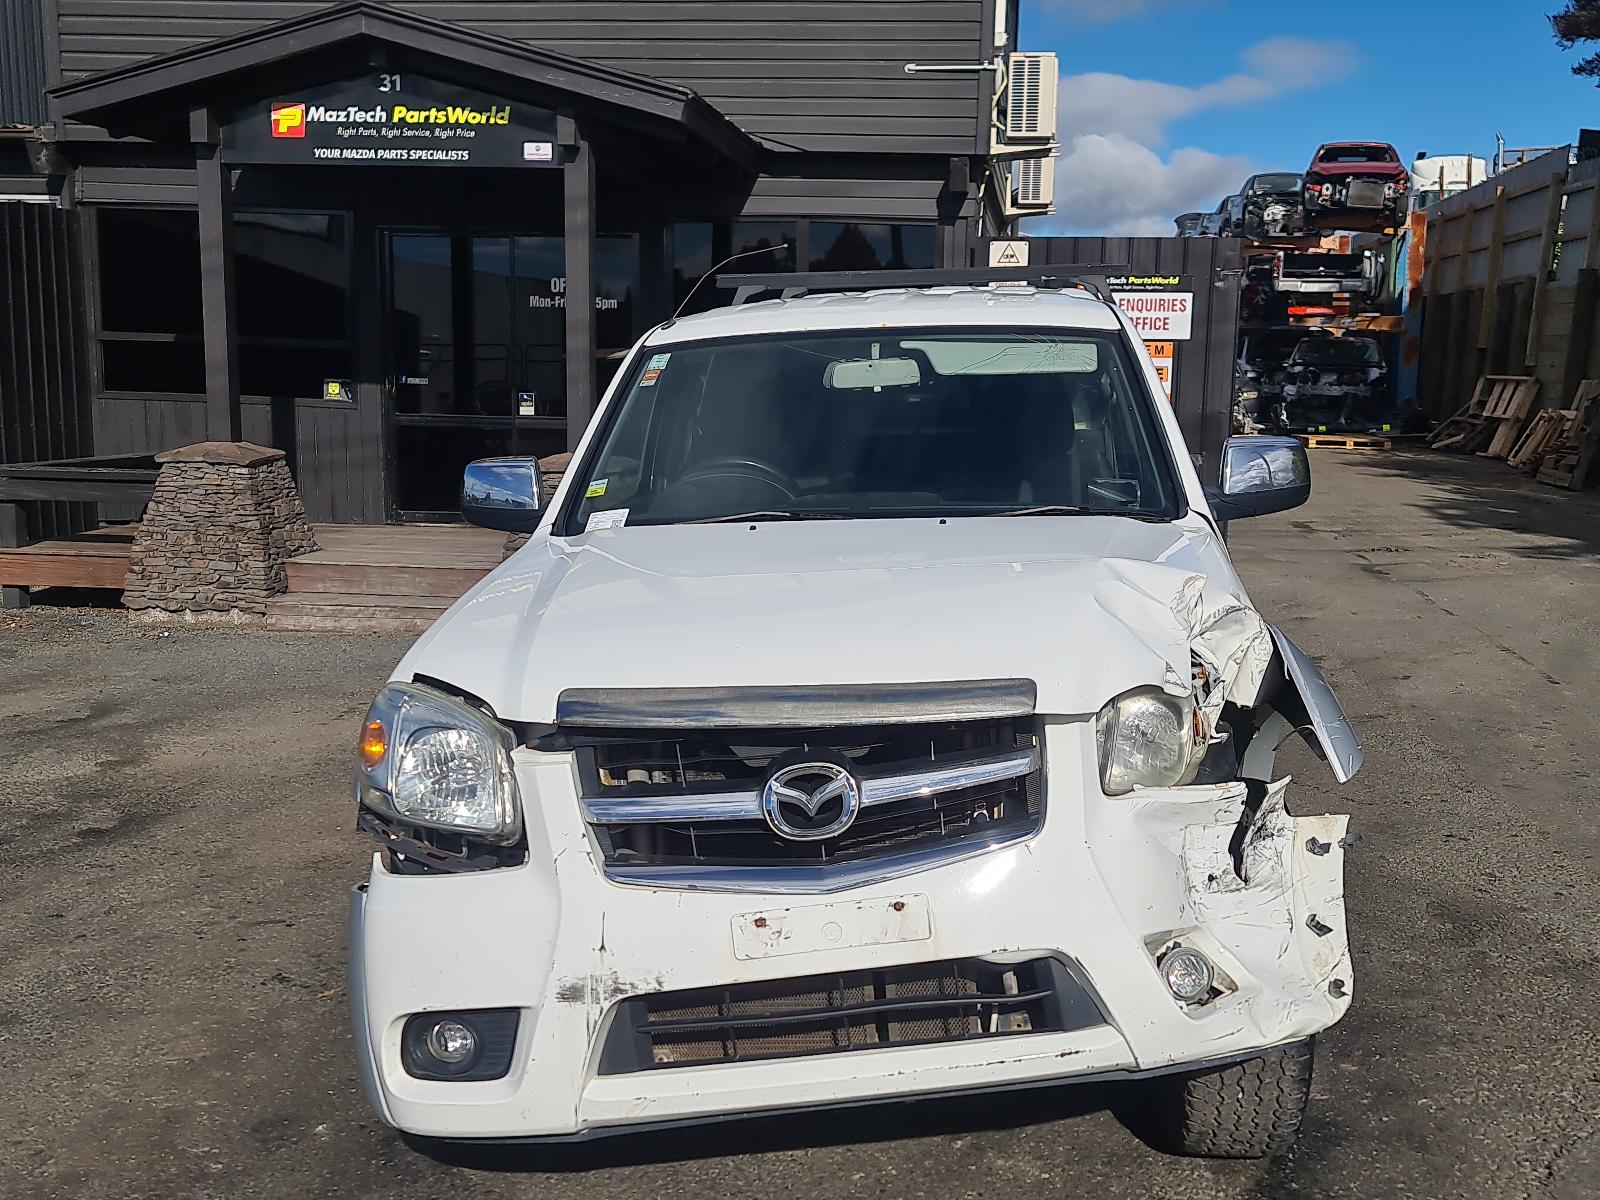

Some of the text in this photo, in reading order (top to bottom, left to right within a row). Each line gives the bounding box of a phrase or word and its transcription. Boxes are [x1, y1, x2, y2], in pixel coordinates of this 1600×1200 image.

[379, 74, 401, 92] 31
[306, 105, 511, 125] MazTech PartsWorld
[336, 127, 476, 139] Right Parts, Right Service, Right Price
[313, 147, 470, 161] YOUR MAZDA PARTS SPECIALISTS
[1128, 276, 1180, 285] PartsWorld
[1119, 298, 1188, 313] ENQUIRIES
